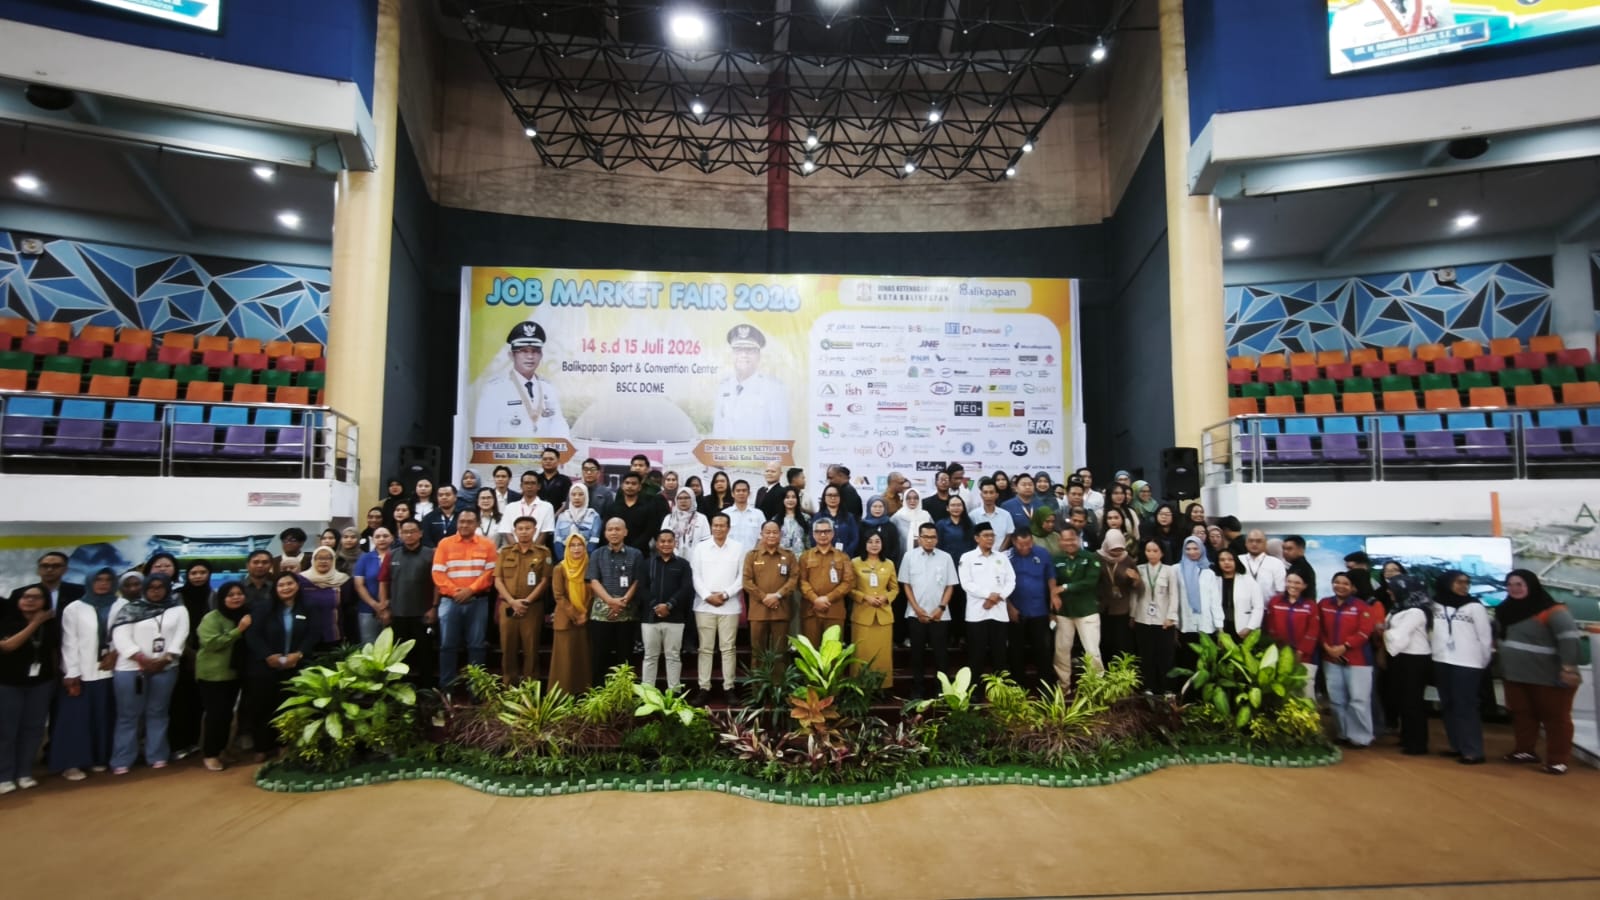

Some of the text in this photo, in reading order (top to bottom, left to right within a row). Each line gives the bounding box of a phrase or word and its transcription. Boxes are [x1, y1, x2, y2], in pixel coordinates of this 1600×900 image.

[486, 277, 801, 312] JOB MARKET FAIR 2026
[581, 338, 702, 355] 14 s.d 15 Juli 2026
[562, 361, 719, 375] Balikpapan Sport & Convention Center
[616, 382, 665, 393] BSCC DOME
[1029, 420, 1054, 430] EKA
[1011, 443, 1027, 452] ISS
